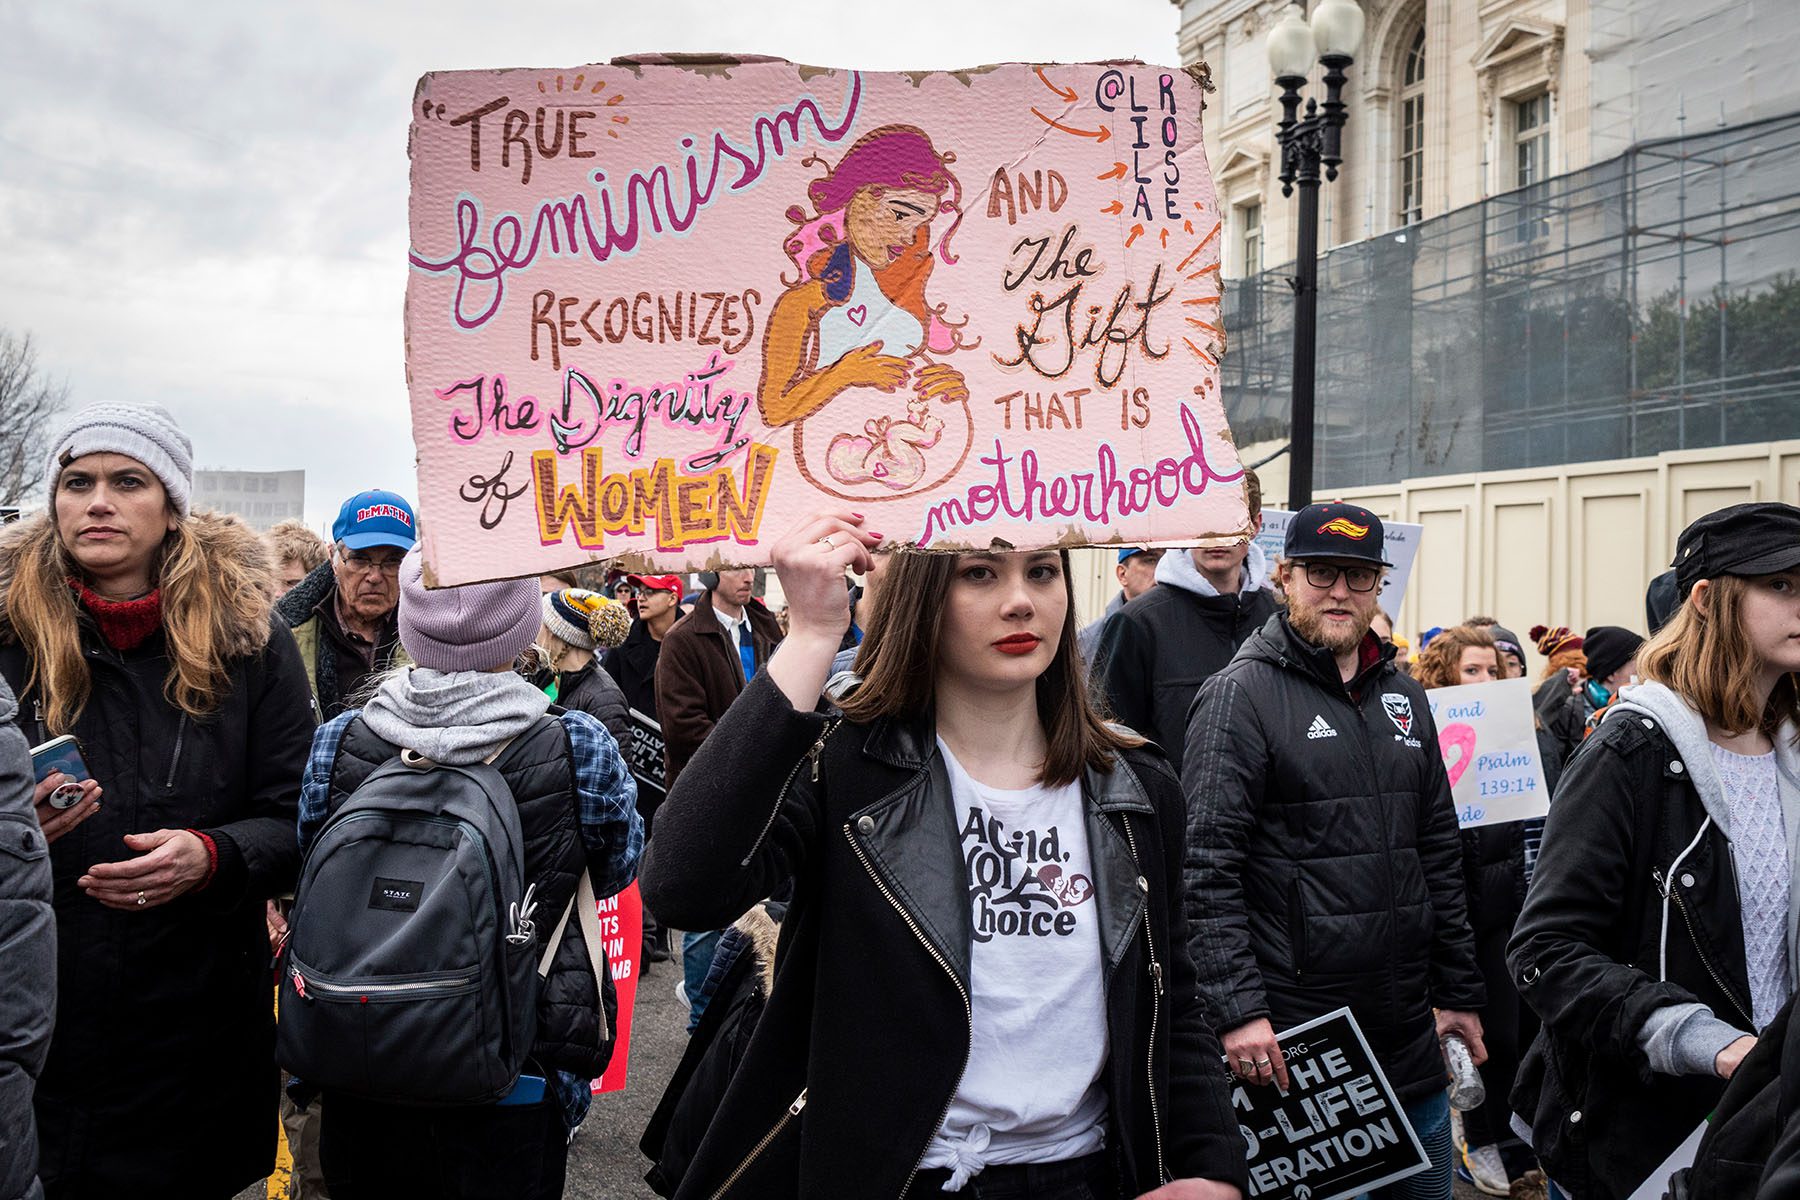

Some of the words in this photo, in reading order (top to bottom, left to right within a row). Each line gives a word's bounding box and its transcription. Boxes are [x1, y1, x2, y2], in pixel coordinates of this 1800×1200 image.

[409, 70, 861, 329] feminism
[986, 166, 1069, 226] AND
[1003, 224, 1098, 292] The
[531, 289, 762, 370] RECOGNIZES
[992, 263, 1175, 389] Gift
[436, 376, 541, 441] The
[550, 354, 750, 473] Dignity
[994, 387, 1092, 431] THAT
[1121, 386, 1151, 431] IS
[459, 450, 529, 530] of
[1307, 728, 1338, 740] adidas
[1448, 701, 1485, 719] and
[1478, 752, 1531, 771] Psalm
[1480, 777, 1537, 796] 139:14
